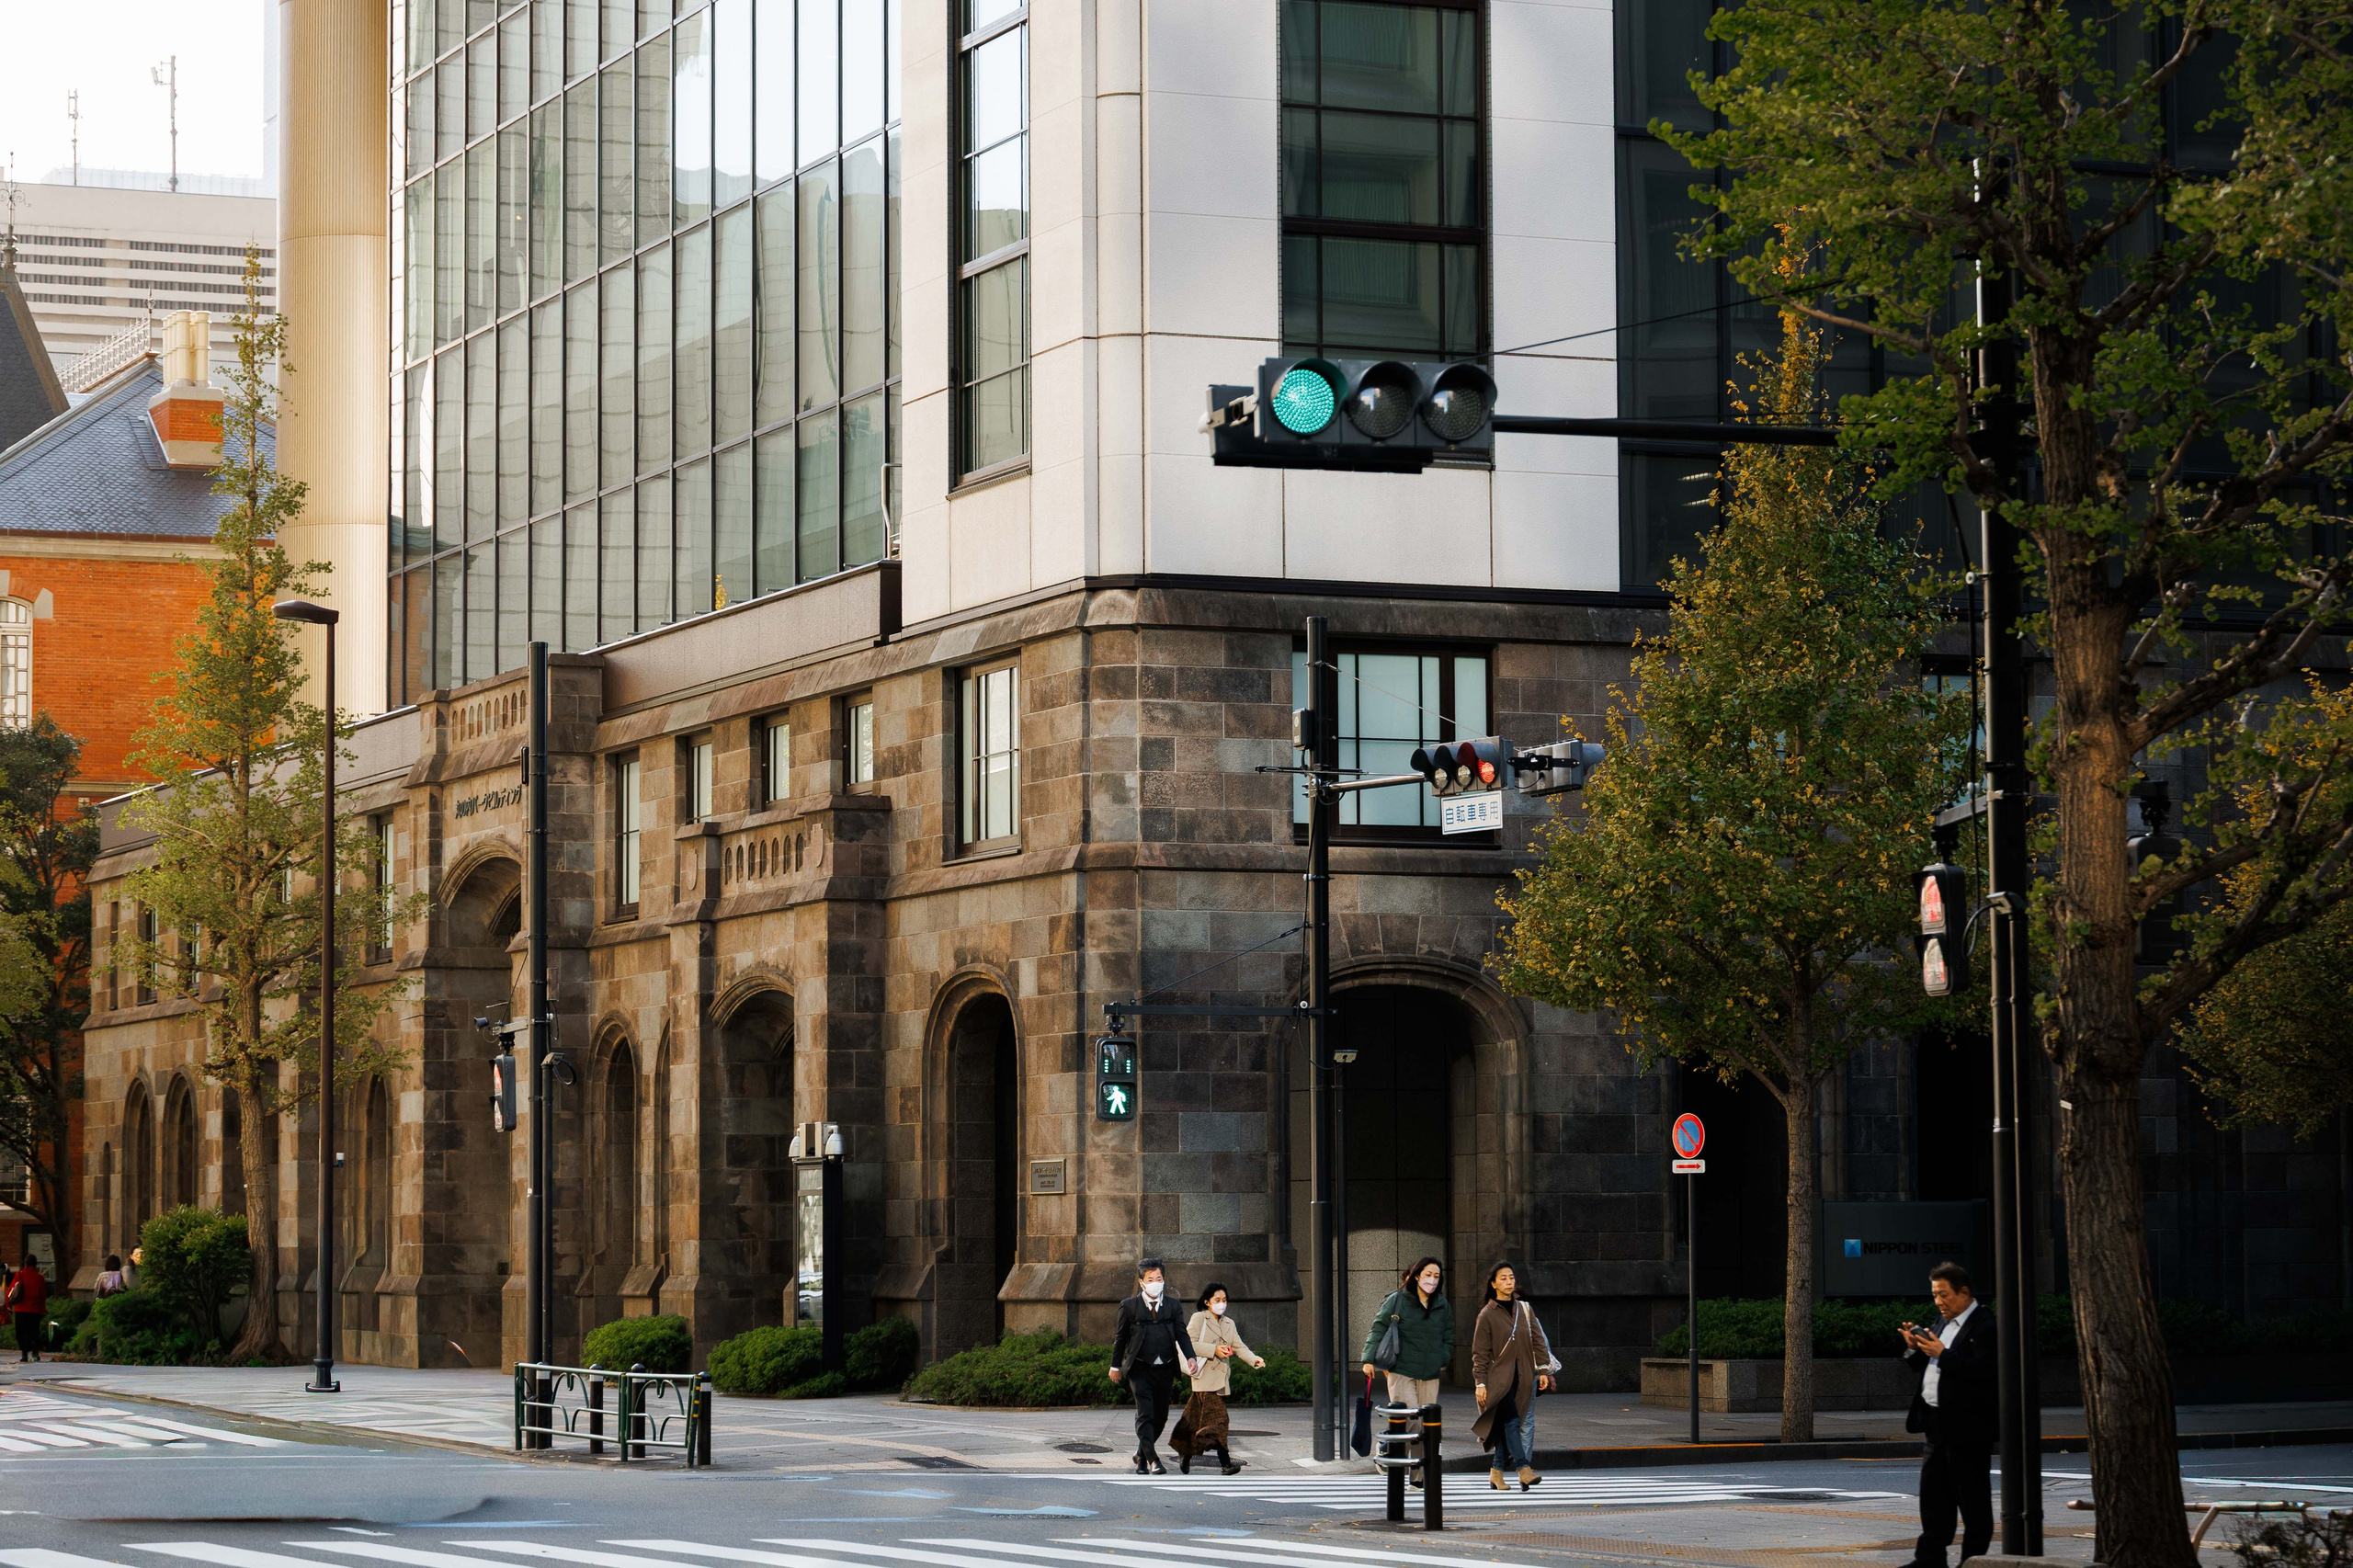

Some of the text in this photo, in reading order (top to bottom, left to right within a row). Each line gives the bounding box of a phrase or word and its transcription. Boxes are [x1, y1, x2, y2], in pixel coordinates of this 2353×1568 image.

[1445, 801, 1498, 825] 自転車専用
[1863, 1242, 1968, 1255] NIPPON STEEL
